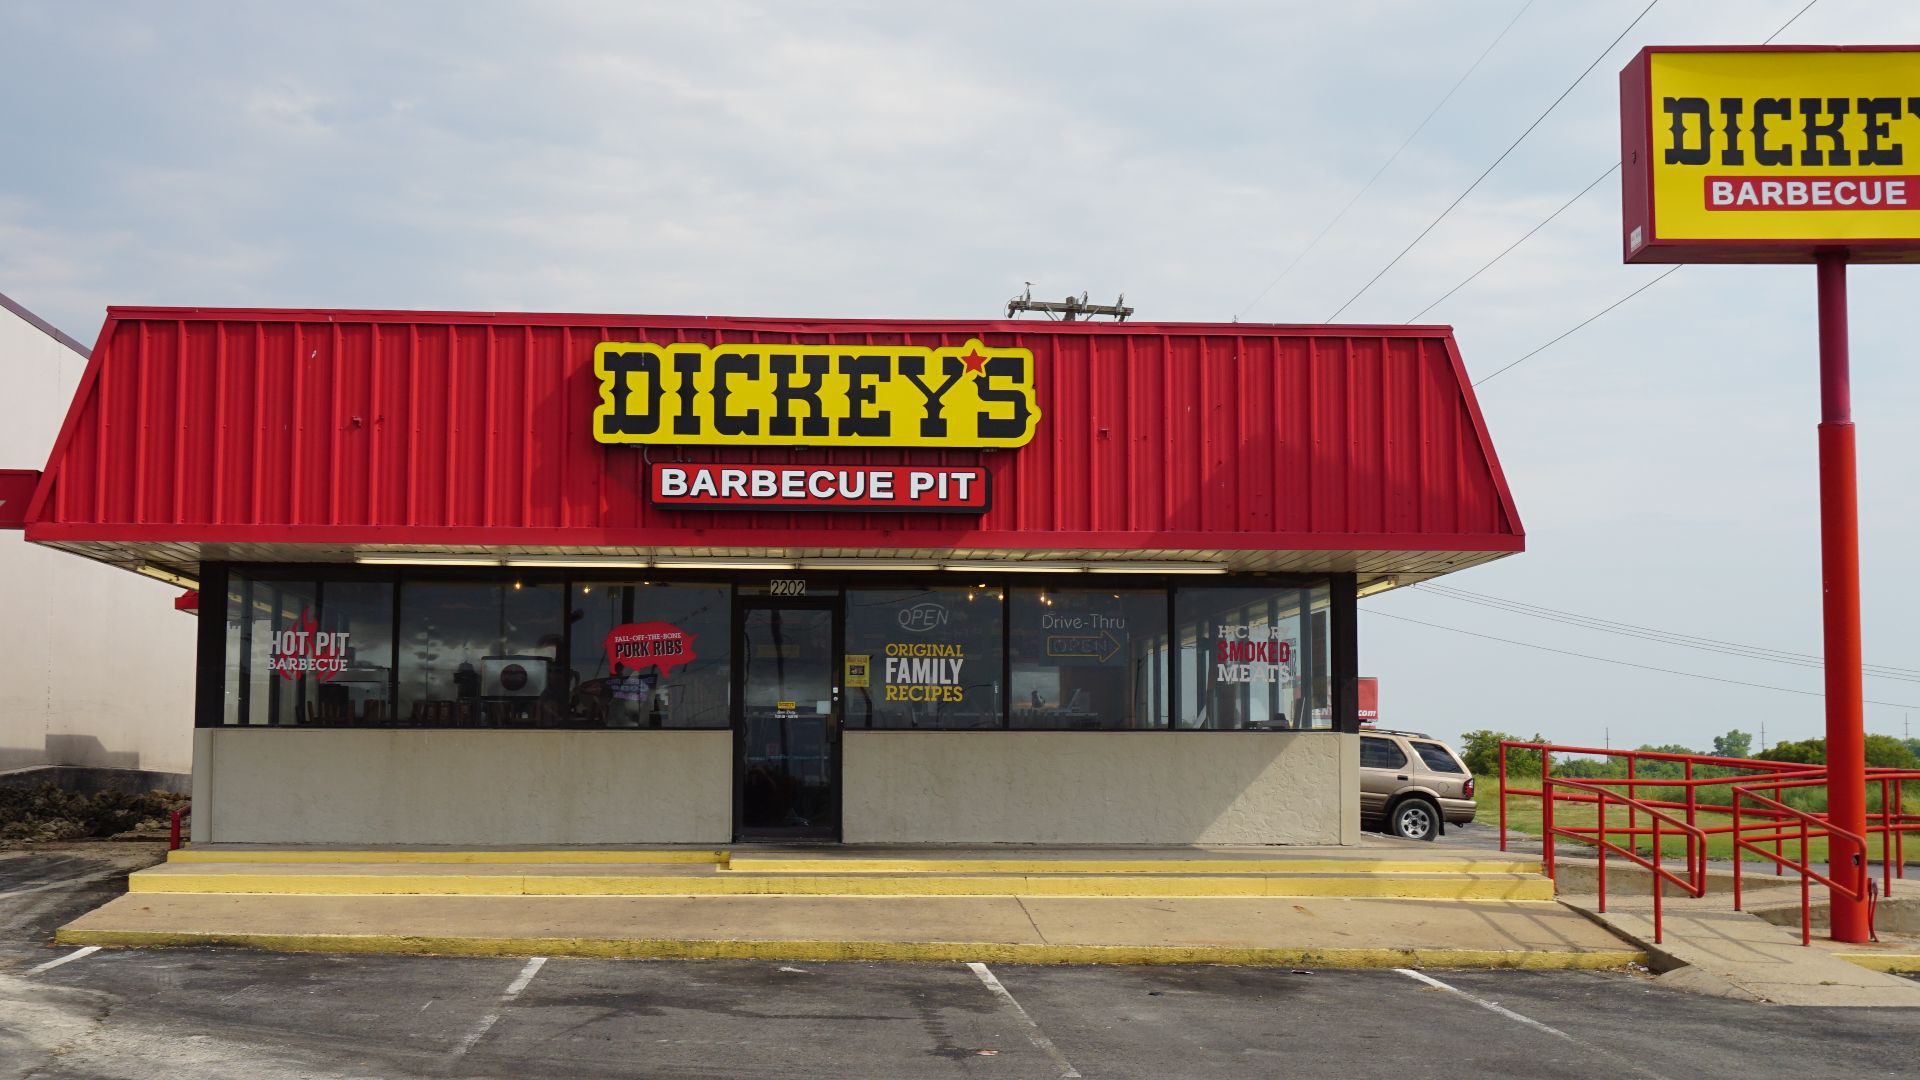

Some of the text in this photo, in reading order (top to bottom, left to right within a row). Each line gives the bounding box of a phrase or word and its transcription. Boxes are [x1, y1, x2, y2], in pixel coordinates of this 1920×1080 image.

[1711, 180, 1907, 206] BARBECUE
[602, 349, 1033, 439] DICKEY'S
[660, 468, 978, 501] BARBECUE PIT
[770, 580, 806, 596] 2202
[898, 608, 949, 627] OPEN
[1042, 613, 1125, 629] Drive-Thru
[615, 632, 682, 643] FALL-OFF-THE-BONE
[1217, 625, 1292, 640] HICRY
[269, 630, 350, 657] HOT PIT
[615, 639, 684, 659] PORK RIBS
[885, 643, 964, 657] ORIGINAL
[1216, 640, 1291, 663] SMOKED
[267, 657, 348, 672] BARBECUE
[885, 657, 964, 685] FAMILY
[1217, 664, 1291, 683] MEATS
[885, 684, 964, 702] RECIPES
